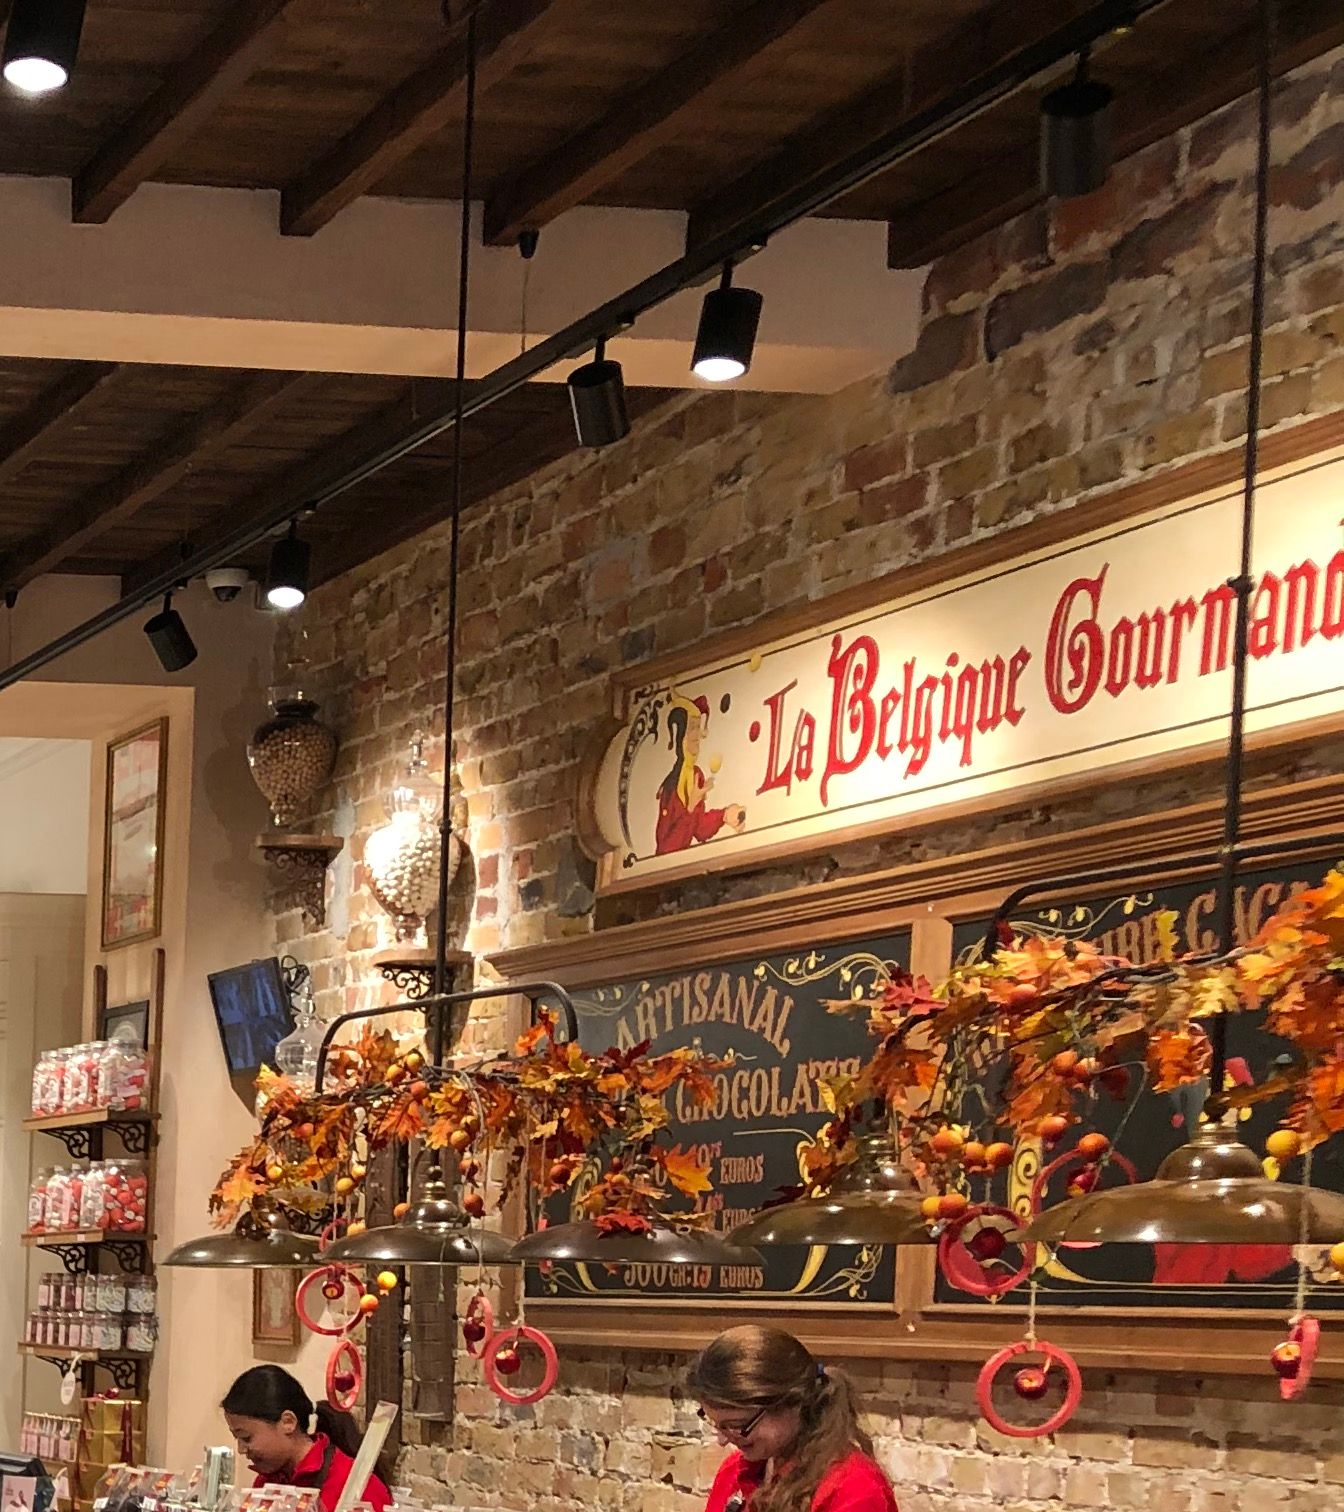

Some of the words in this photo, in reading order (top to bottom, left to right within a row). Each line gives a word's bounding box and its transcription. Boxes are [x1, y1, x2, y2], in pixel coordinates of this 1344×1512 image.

[756, 678, 816, 797] La
[820, 632, 1032, 808] Belgique
[615, 971, 795, 1059] ARTISANAL
[719, 1153, 764, 1184] EUROS
